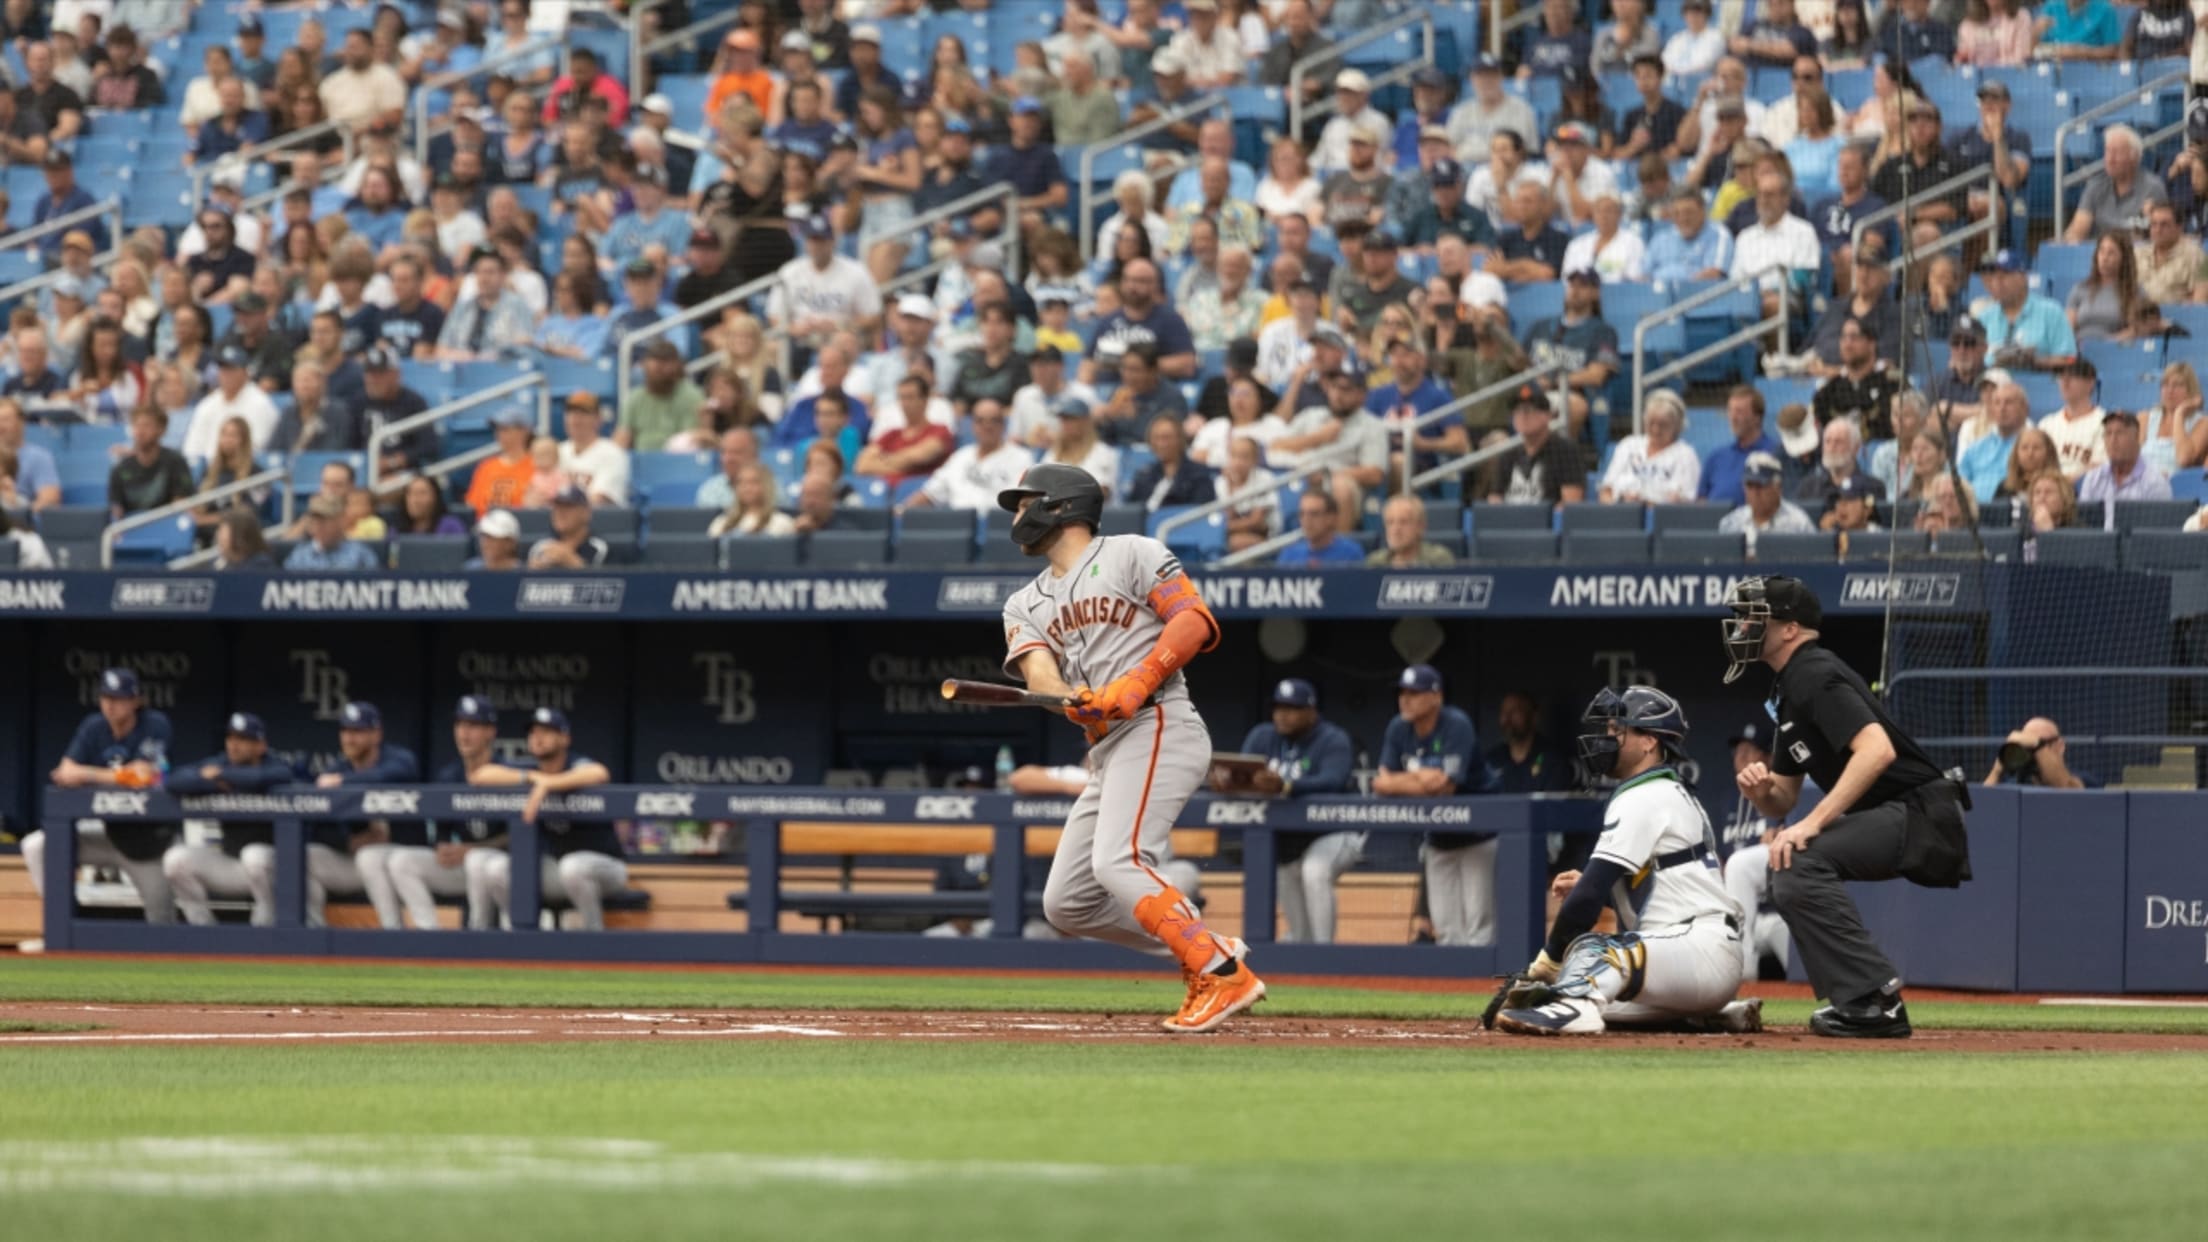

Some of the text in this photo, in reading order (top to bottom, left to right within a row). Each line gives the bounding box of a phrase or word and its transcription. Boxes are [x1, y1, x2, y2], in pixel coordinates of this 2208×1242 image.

[261, 580, 470, 610] AMERANT BANK
[672, 579, 889, 610] AMERANT BANK
[1247, 577, 1324, 609] BANK
[1550, 575, 1701, 607] AMERANT
[693, 652, 757, 724] TB
[657, 751, 793, 784] ORLANDO
[91, 791, 149, 815] DEX
[362, 790, 421, 814] DEX
[635, 792, 696, 816] DEX
[727, 795, 886, 816] RAYSBASEBALL.COM
[914, 796, 977, 820] DEX
[1206, 801, 1270, 825] DEX
[1306, 804, 1472, 825] RAYSBASEBALL.COM
